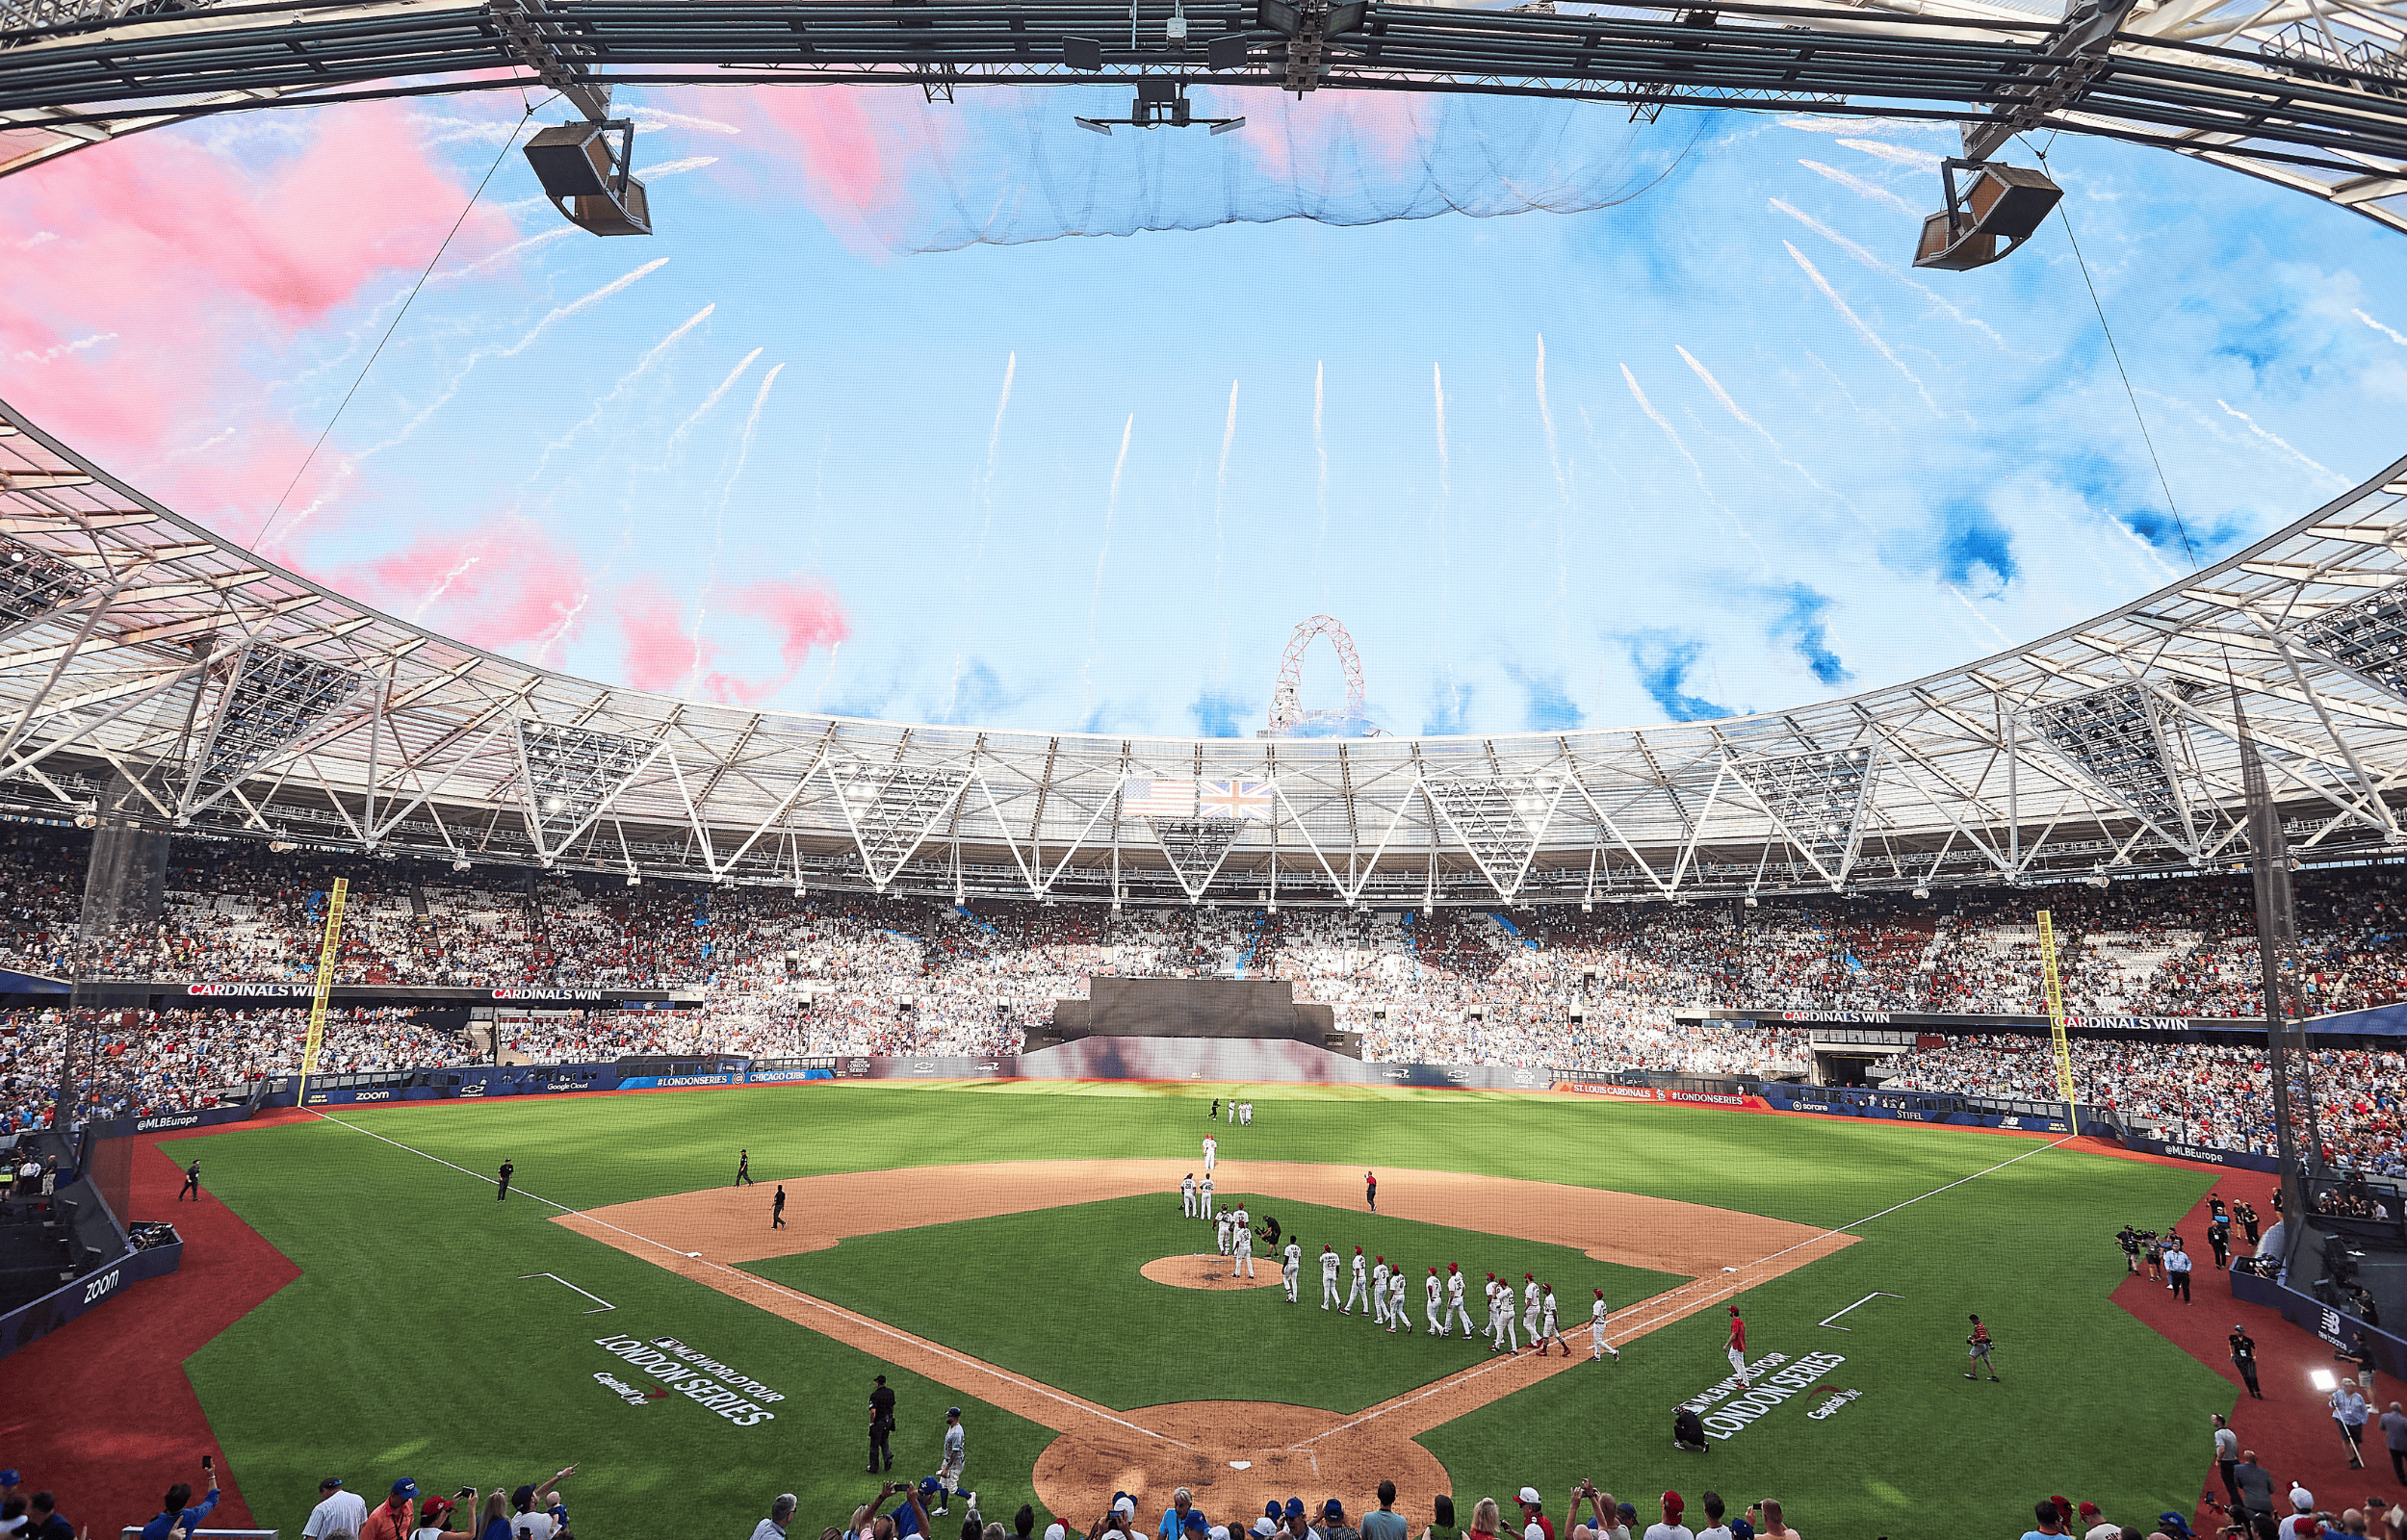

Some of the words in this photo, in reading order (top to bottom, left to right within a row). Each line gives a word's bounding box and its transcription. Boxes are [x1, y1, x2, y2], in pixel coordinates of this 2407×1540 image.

[187, 984, 288, 996] CARDINALS
[492, 989, 572, 1000] CARDINALS
[574, 989, 602, 1000] WIN
[1782, 1013, 1860, 1023] CARDINALS
[1861, 1014, 1890, 1023] WIN
[2054, 1016, 2151, 1030] CARDINALS
[2151, 1018, 2189, 1030] WIN
[657, 1075, 728, 1087] #LONDONSERIES
[750, 1072, 786, 1083] CHICAGO
[786, 1071, 806, 1080] CUBS
[355, 1091, 390, 1101] zoom
[1573, 1084, 1586, 1093] ST.
[1586, 1085, 1607, 1095] LOUIS
[1607, 1087, 1651, 1098] CARDINALS
[1671, 1091, 1744, 1105] #LONDONSERIES
[1802, 1102, 1828, 1112] sorare
[1896, 1109, 1924, 1120] STIFEL
[137, 1115, 198, 1131] @MLBEurope
[2164, 1144, 2223, 1163] @MLBEurope
[1327, 1259, 1336, 1268] 22
[84, 1269, 119, 1304] zoom
[593, 1334, 700, 1383] LONDON
[673, 1378, 775, 1426] SERIES
[667, 1346, 706, 1361] MLB
[693, 1357, 750, 1384] WORLD
[737, 1380, 786, 1403] TOUR
[1696, 1387, 1731, 1405] MLB
[1750, 1352, 1792, 1370] TOUR
[1702, 1382, 1798, 1440] LONDON
[1769, 1350, 1847, 1389] SERIES
